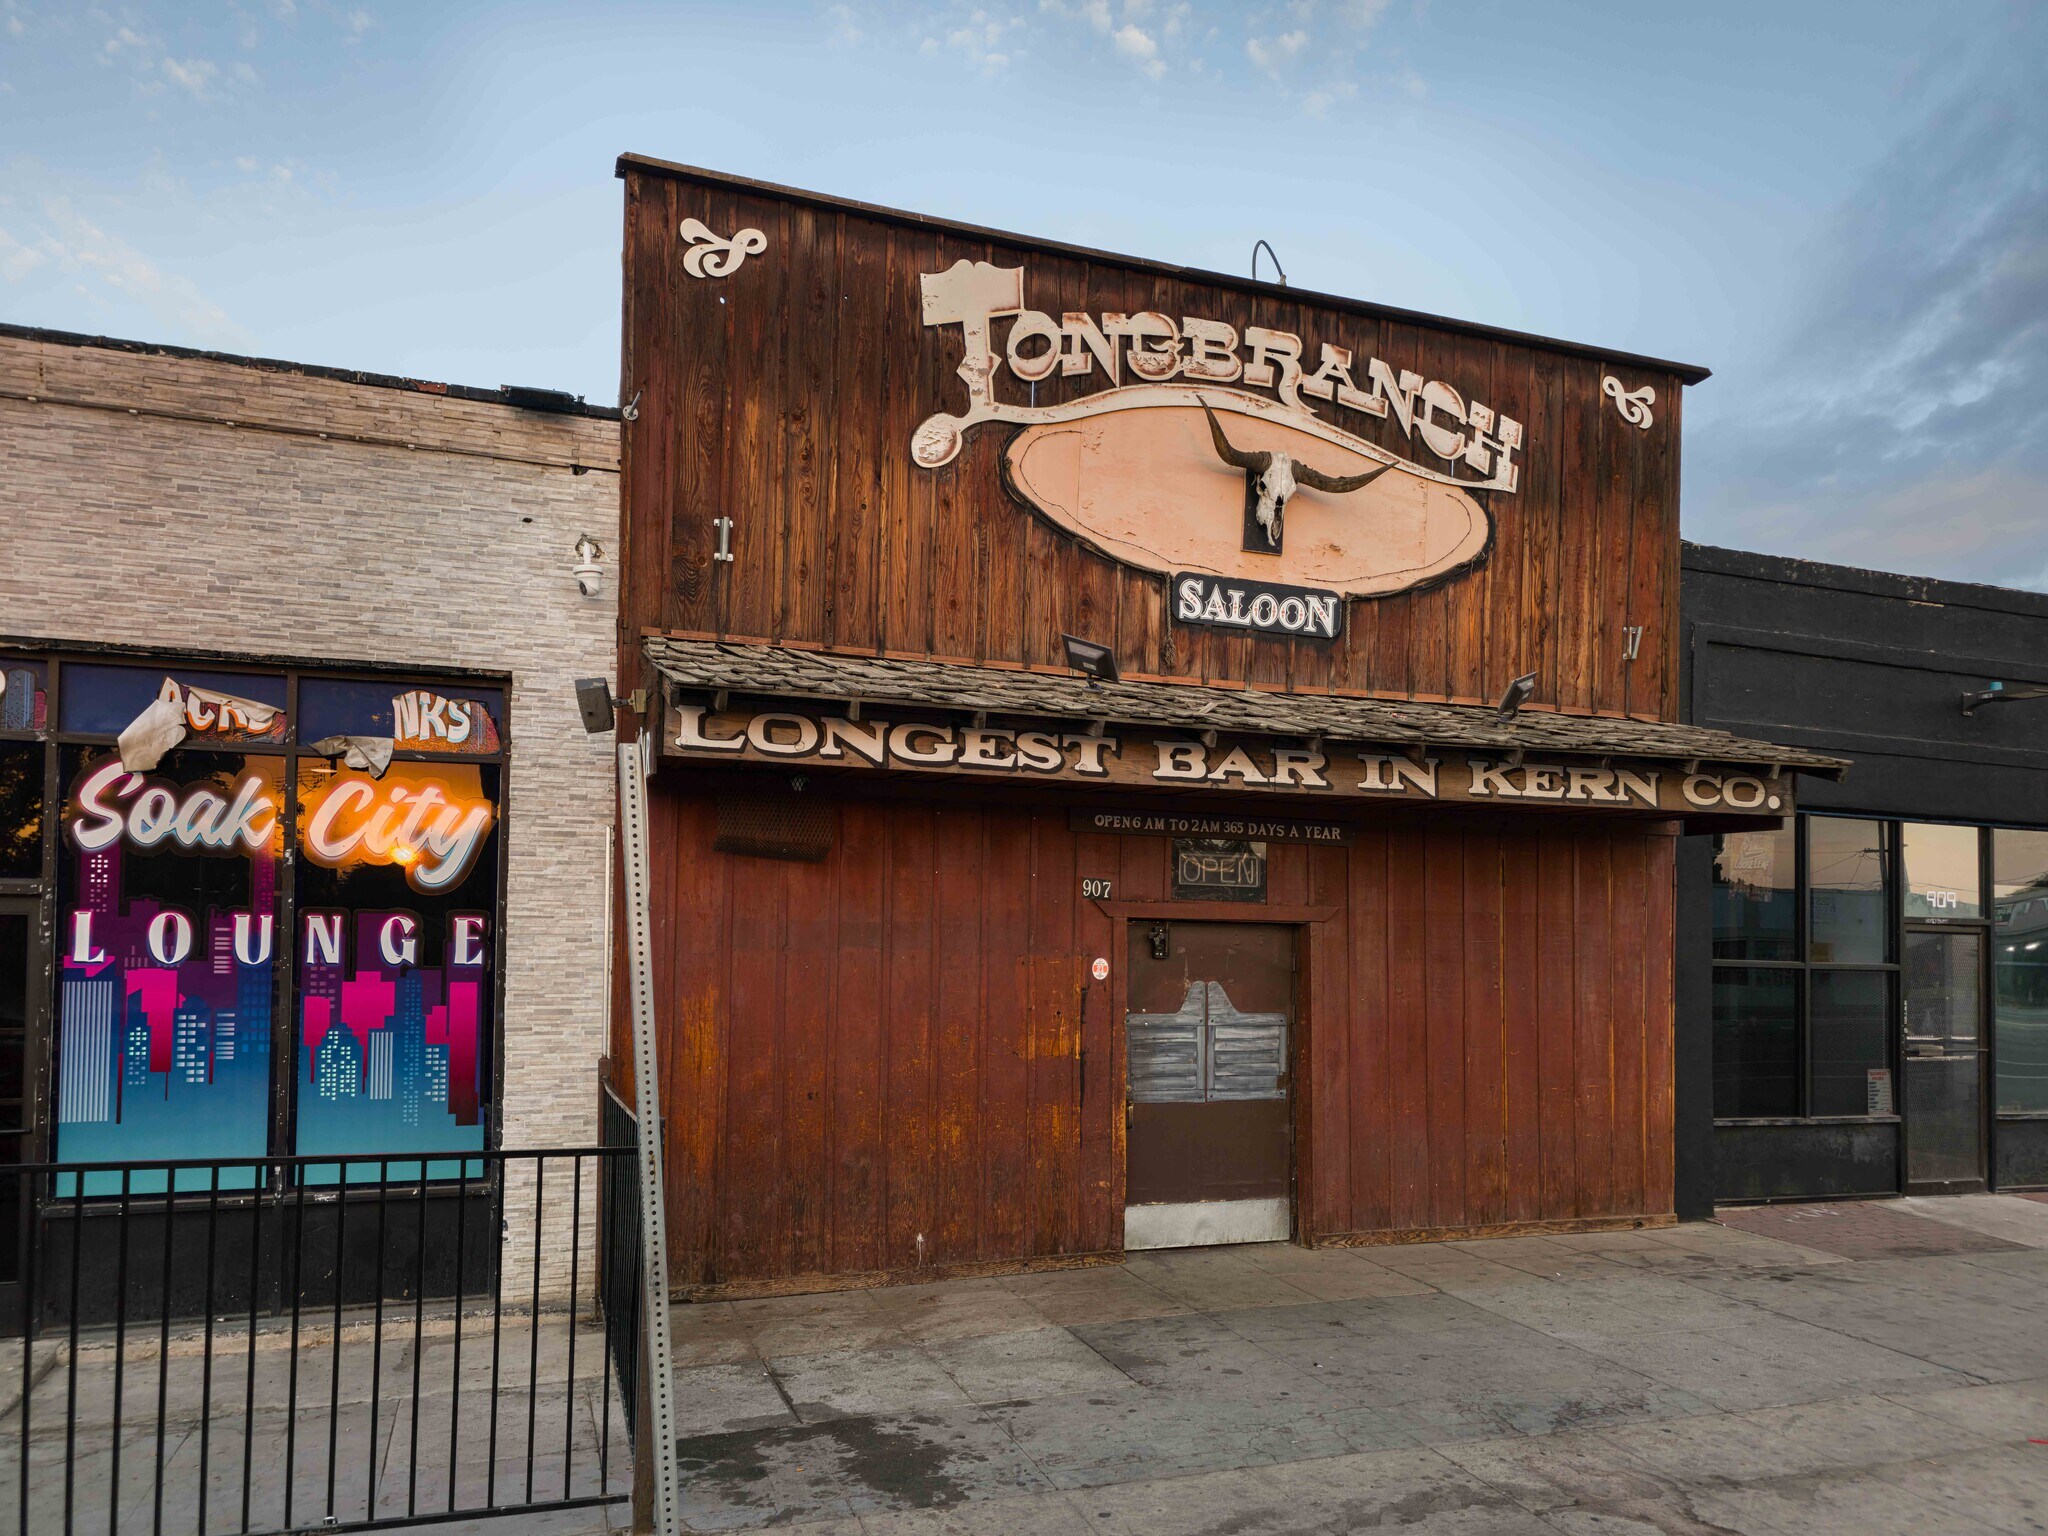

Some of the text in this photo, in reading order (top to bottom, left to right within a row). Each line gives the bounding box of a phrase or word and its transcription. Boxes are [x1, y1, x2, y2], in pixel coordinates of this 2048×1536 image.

[1178, 579, 1338, 638] SALOON
[674, 705, 1782, 810] LONGEST BAR IN KERN CO.
[73, 760, 492, 885] Soak City
[1144, 818, 1165, 830] AM
[1169, 818, 1188, 832] TO
[1223, 821, 1244, 834] 365
[1248, 823, 1285, 836] DAYS
[1290, 825, 1299, 838] A
[1304, 825, 1341, 840] YEAR
[1082, 879, 1111, 898] 907
[1183, 857, 1254, 884] OPEN
[1926, 891, 1957, 909] 909
[73, 911, 485, 965] LOUNGE
